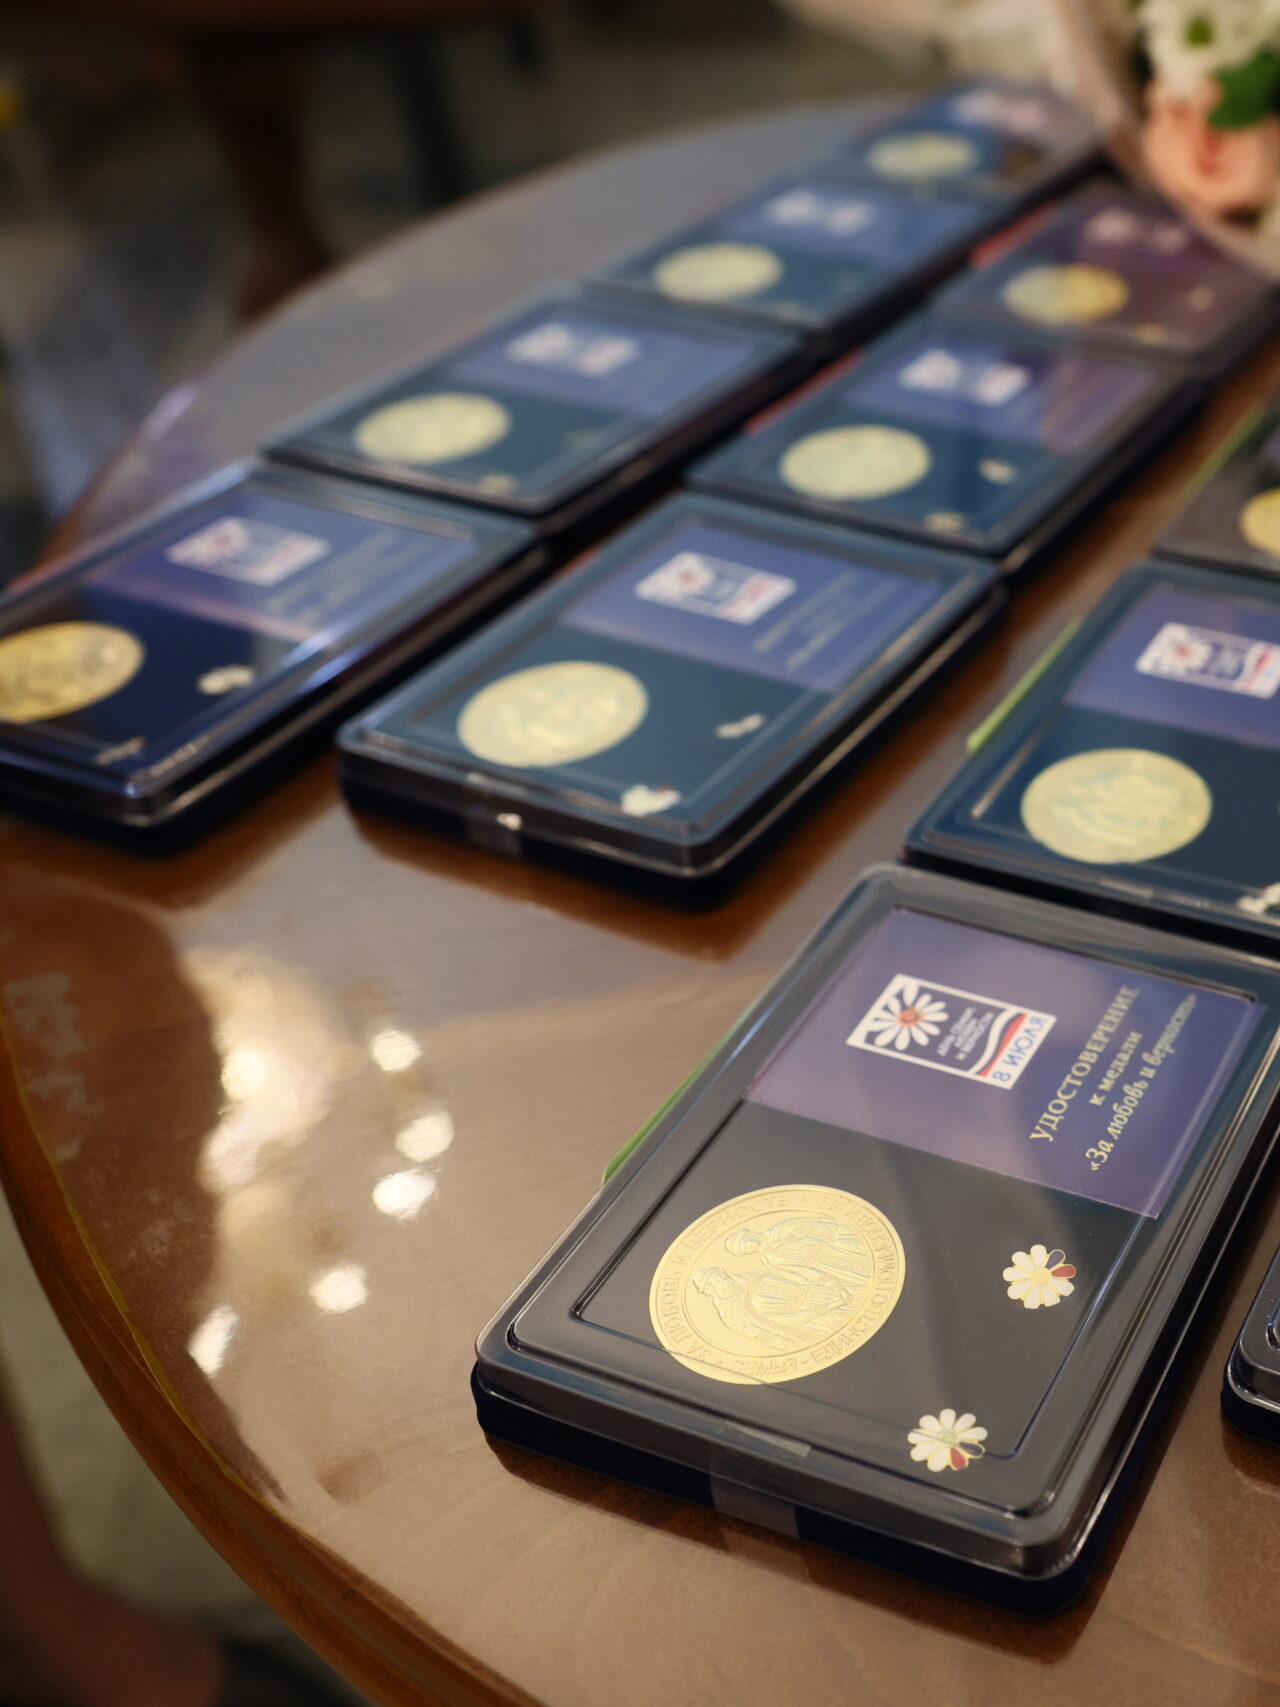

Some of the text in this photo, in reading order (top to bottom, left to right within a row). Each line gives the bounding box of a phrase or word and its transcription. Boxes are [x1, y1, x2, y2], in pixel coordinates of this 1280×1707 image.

[992, 1015, 1048, 1083] 8 ИЮЛЯ
[1029, 985, 1140, 1143] УДОСТОВЕРЕНИЕ
[1088, 1030, 1143, 1107] к медали
[1085, 1140, 1116, 1172] «За
[1106, 1077, 1149, 1139] любовь
[1138, 1065, 1157, 1079] и
